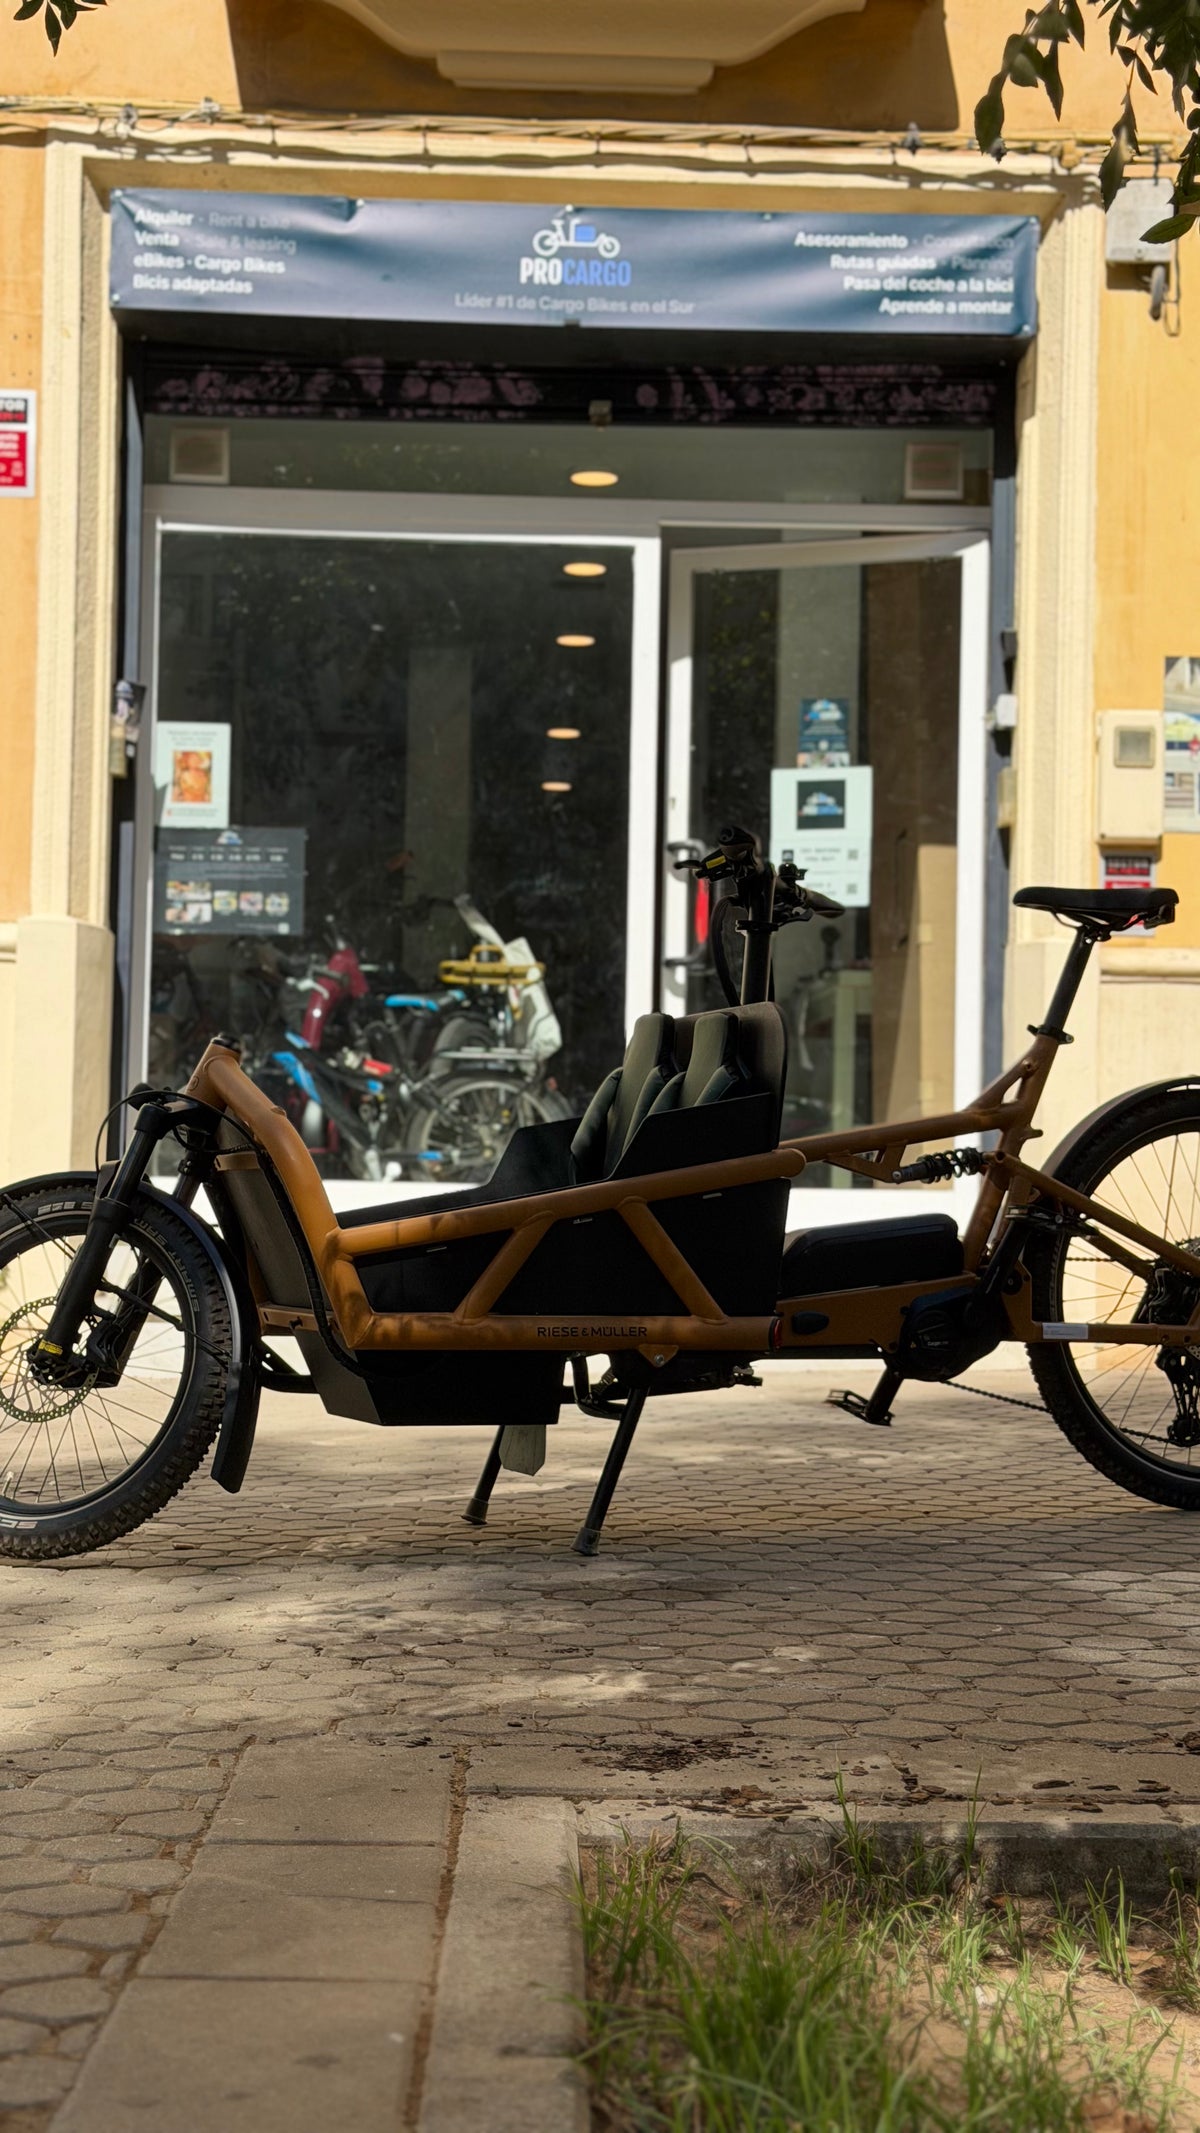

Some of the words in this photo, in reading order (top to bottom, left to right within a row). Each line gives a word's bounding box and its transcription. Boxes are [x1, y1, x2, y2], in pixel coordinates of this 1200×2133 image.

[135, 209, 194, 227] Alquiler
[135, 230, 180, 246] Venta
[244, 235, 297, 255] leasing
[794, 232, 908, 249] Asesoramiento
[133, 253, 185, 269] eBikes
[194, 254, 242, 274] Cargo
[243, 257, 286, 274] Bikes
[520, 257, 632, 287] PROCARGO
[830, 253, 874, 269] Rutas
[876, 255, 937, 272] guiadas
[132, 274, 170, 290] Bicis
[172, 276, 253, 294] adaptadas
[843, 276, 881, 290] Pasa
[882, 276, 907, 291] del
[908, 276, 955, 292] coche
[957, 279, 968, 292] a
[969, 278, 984, 292] la
[986, 277, 1014, 292] bici
[455, 293, 493, 309] Líder
[516, 295, 536, 310] de
[539, 296, 585, 314] Cargo
[587, 298, 628, 313] Bikes
[630, 301, 650, 313] en
[652, 299, 666, 313] el
[668, 299, 695, 314] Sur
[878, 297, 944, 316] Aprende
[946, 301, 957, 314] a
[958, 300, 1014, 314] montar
[537, 1326, 579, 1338] RIESE
[582, 1328, 589, 1337] &
[590, 1325, 648, 1338] MÜLLER
